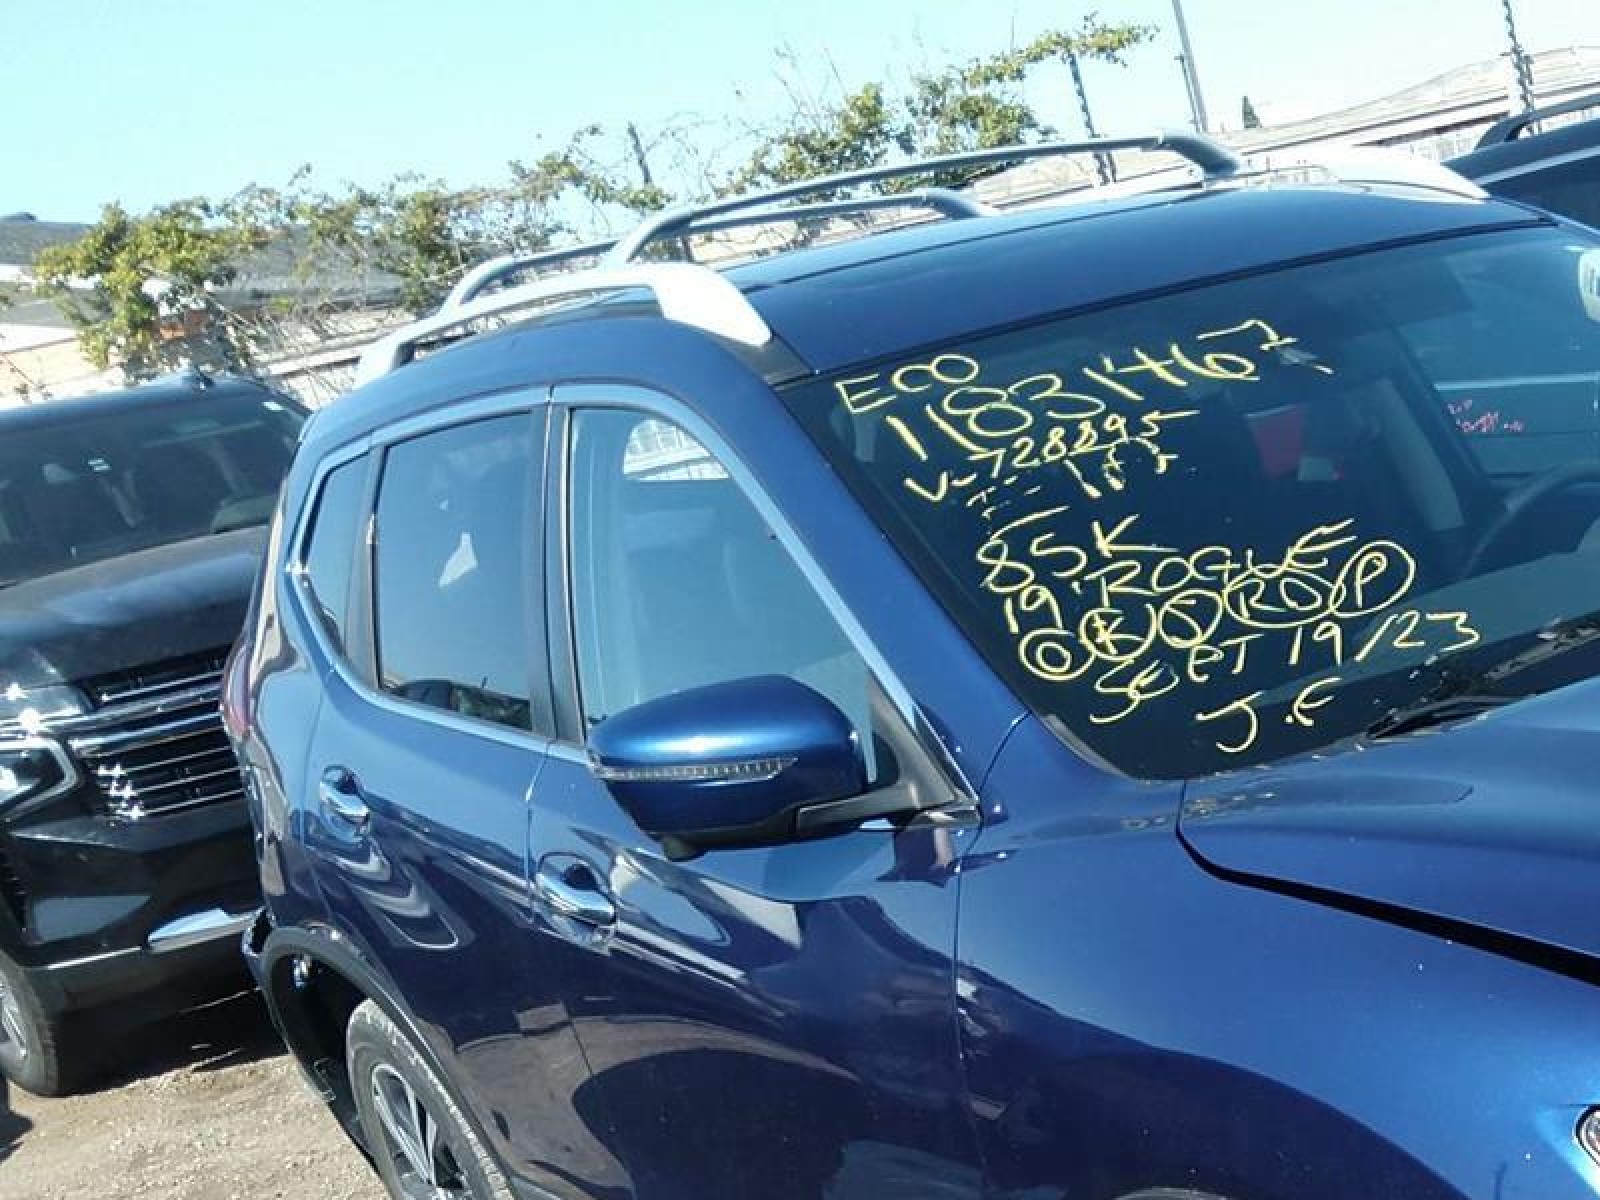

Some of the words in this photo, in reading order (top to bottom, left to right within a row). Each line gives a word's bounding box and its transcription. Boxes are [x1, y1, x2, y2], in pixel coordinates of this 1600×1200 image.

[834, 354, 979, 413] ECO
[887, 319, 1298, 462] 11831467
[1084, 516, 1360, 607] ROGUE
